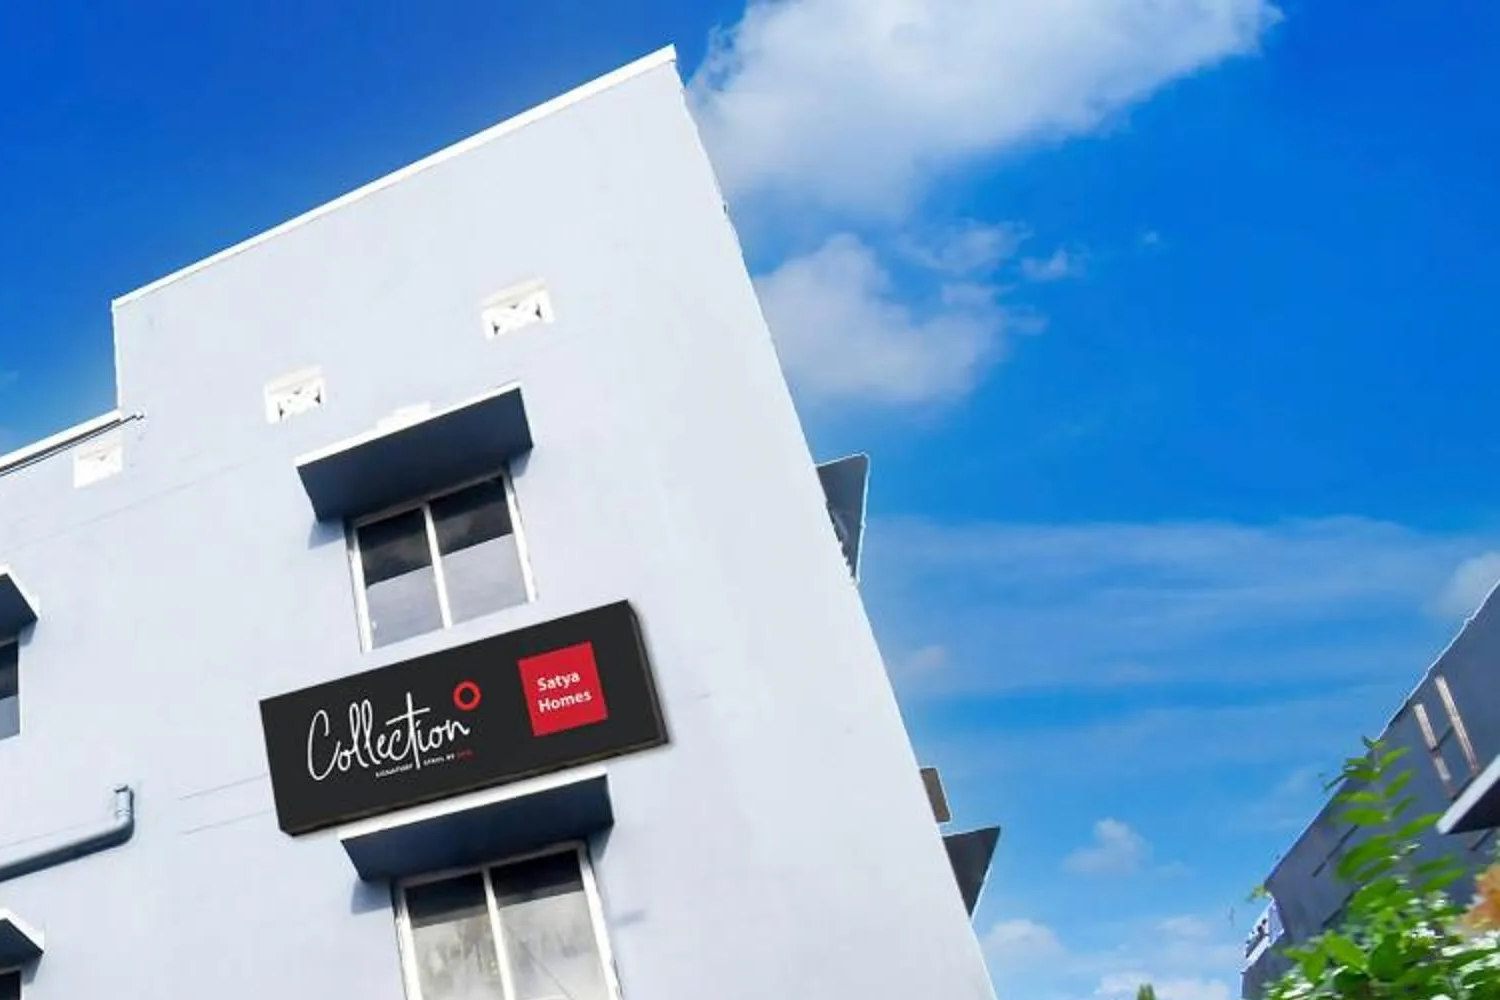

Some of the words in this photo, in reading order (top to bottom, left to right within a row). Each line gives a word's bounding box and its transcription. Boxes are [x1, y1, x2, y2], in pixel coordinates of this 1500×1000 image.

[537, 672, 581, 692] Satya
[538, 691, 592, 713] Homes
[307, 692, 470, 781] Collection
